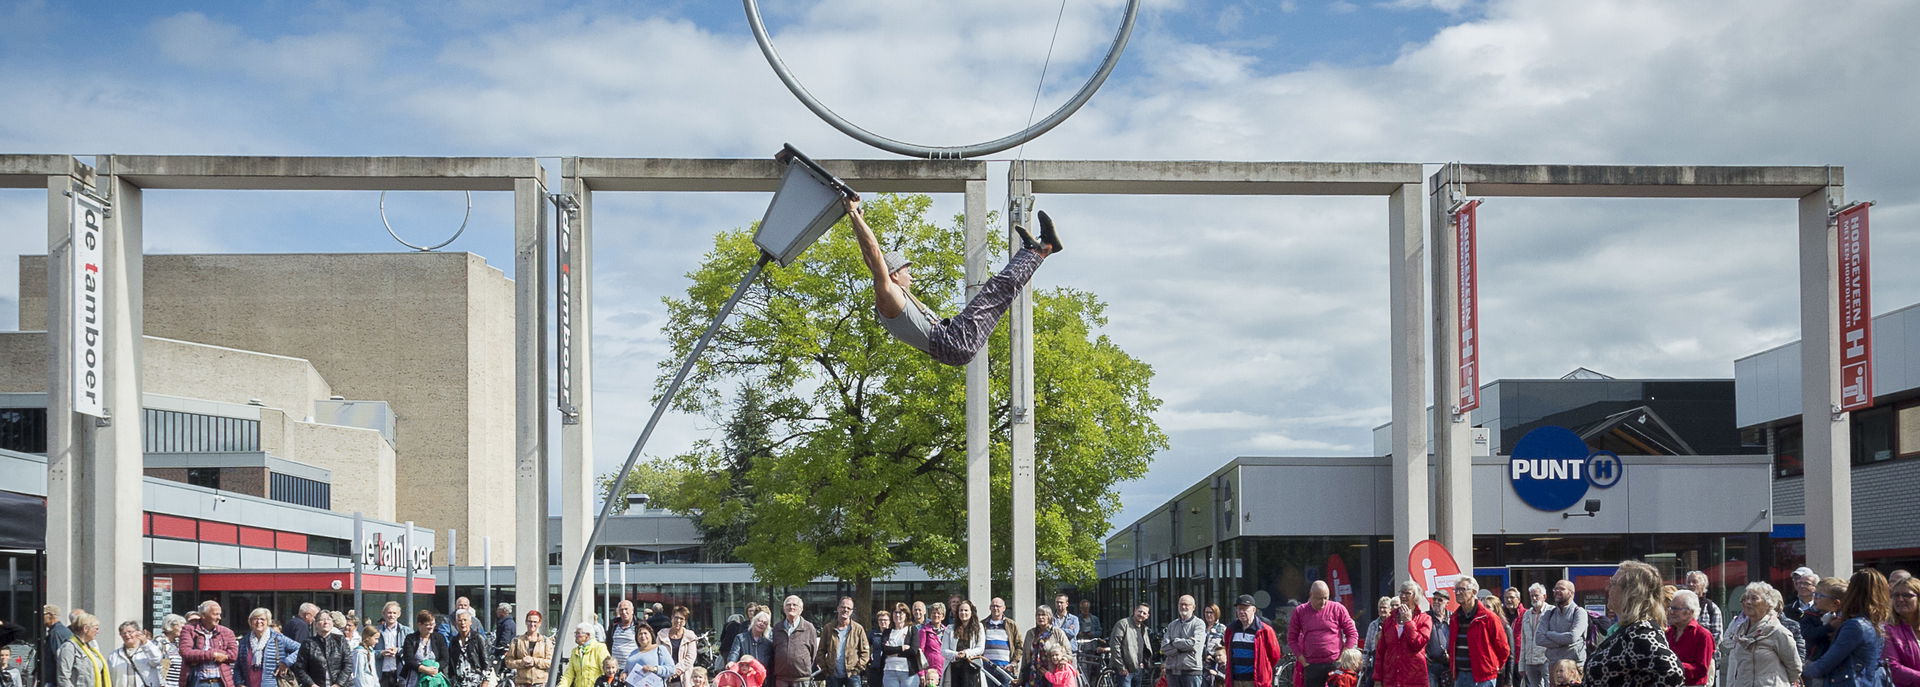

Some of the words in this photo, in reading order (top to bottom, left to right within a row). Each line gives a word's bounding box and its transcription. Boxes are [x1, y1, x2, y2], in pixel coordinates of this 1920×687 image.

[85, 209, 99, 250] de
[1850, 216, 1861, 326] HOOGEVEEN.
[85, 263, 99, 405] tamboer
[1512, 459, 1584, 480] PUNT
[1594, 460, 1613, 479] H
[376, 533, 433, 571] tamoer
